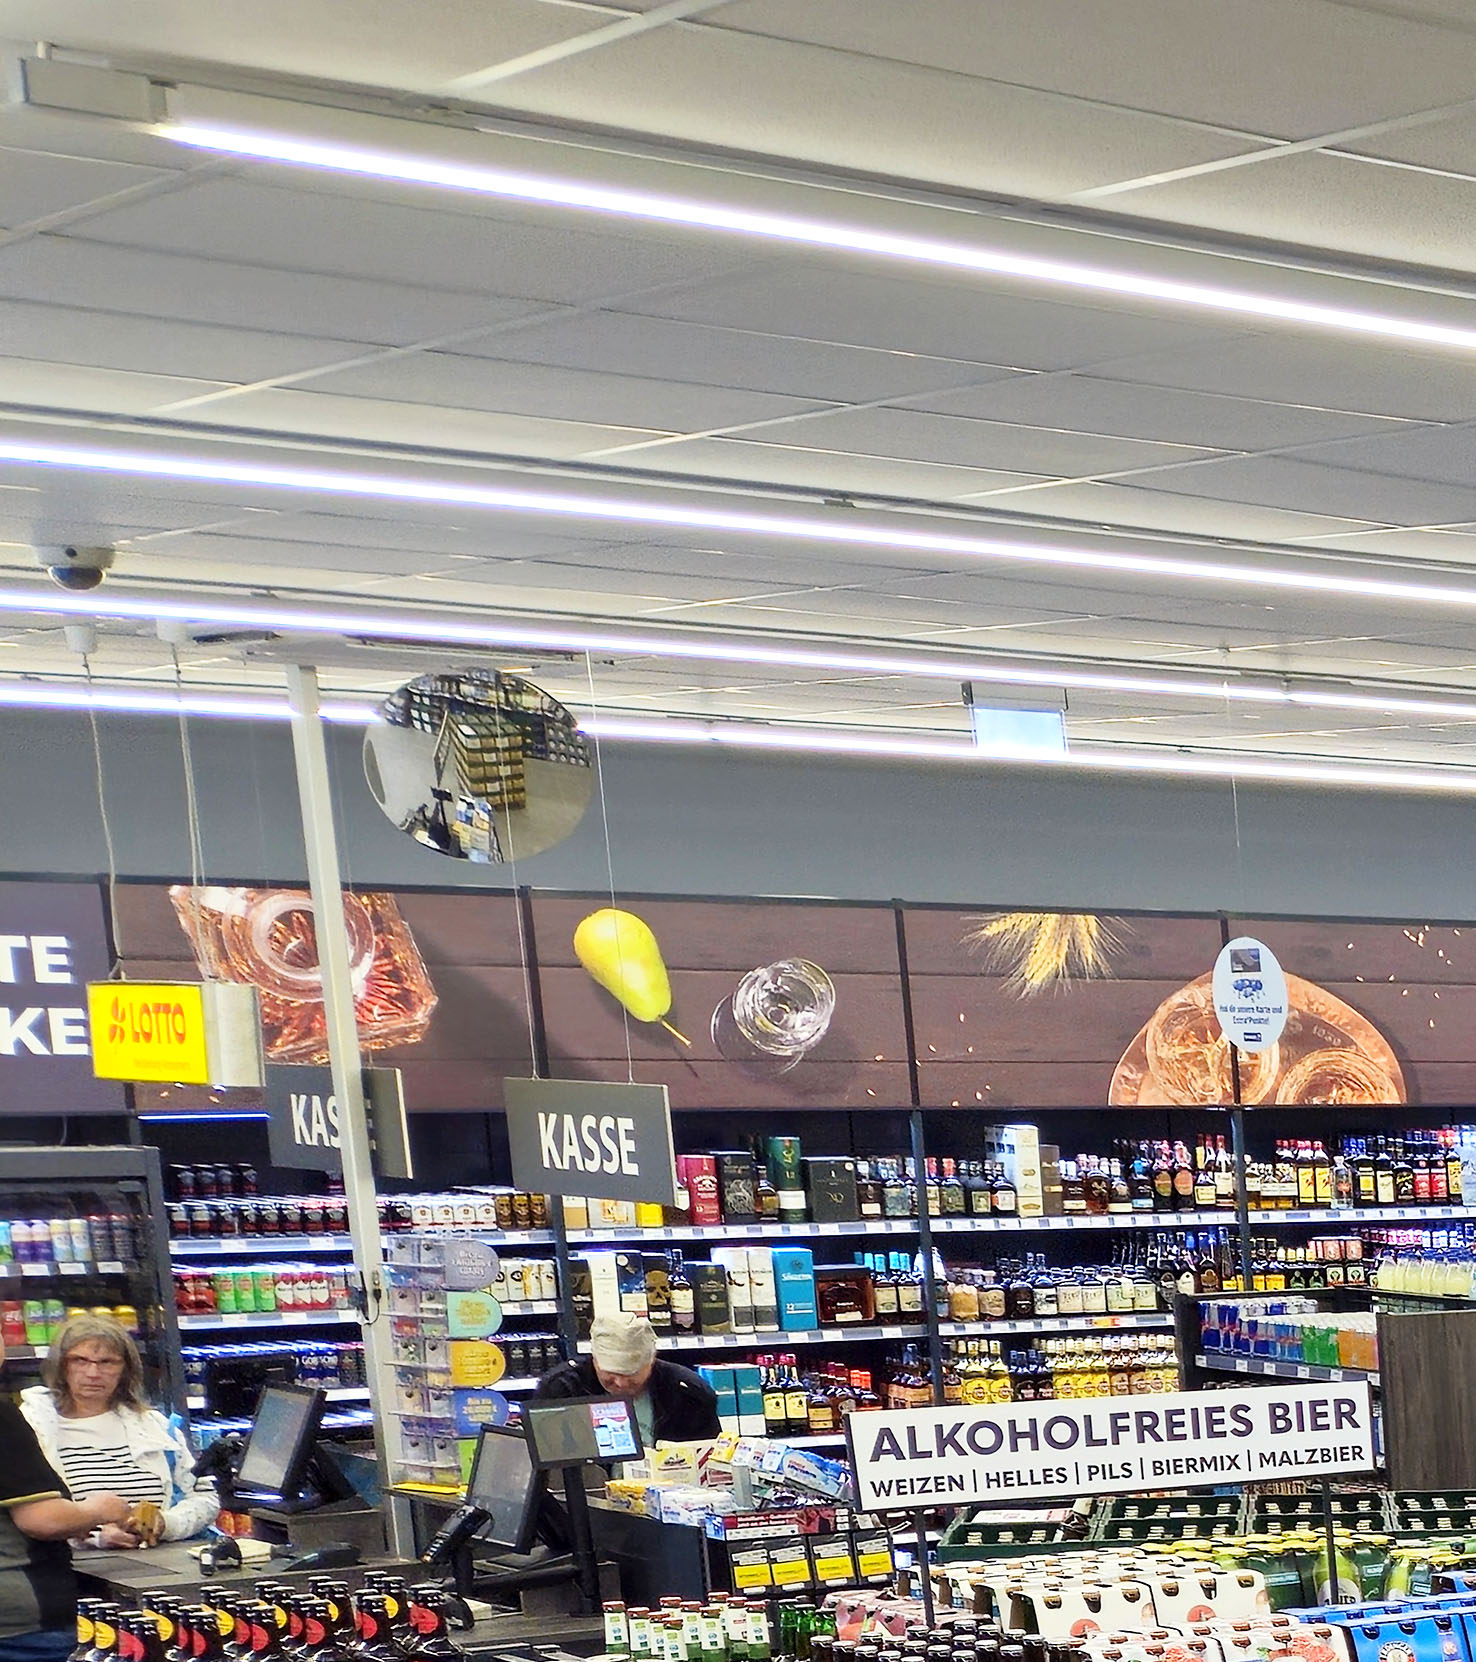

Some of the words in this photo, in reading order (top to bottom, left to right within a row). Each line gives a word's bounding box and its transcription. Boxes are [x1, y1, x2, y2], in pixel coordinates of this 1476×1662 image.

[131, 1003, 186, 1044] LOTTO
[291, 1094, 376, 1151] KAS
[538, 1113, 639, 1175] KASSE
[869, 1403, 1254, 1464] ALKOHOLFREIES
[1268, 1397, 1361, 1436] BIER
[869, 1472, 965, 1498] WEIZEN
[985, 1464, 1068, 1489] HELLES
[1086, 1458, 1133, 1482] PILS
[1151, 1452, 1240, 1478] BIERMIX
[1259, 1443, 1365, 1470] MALZBIER
